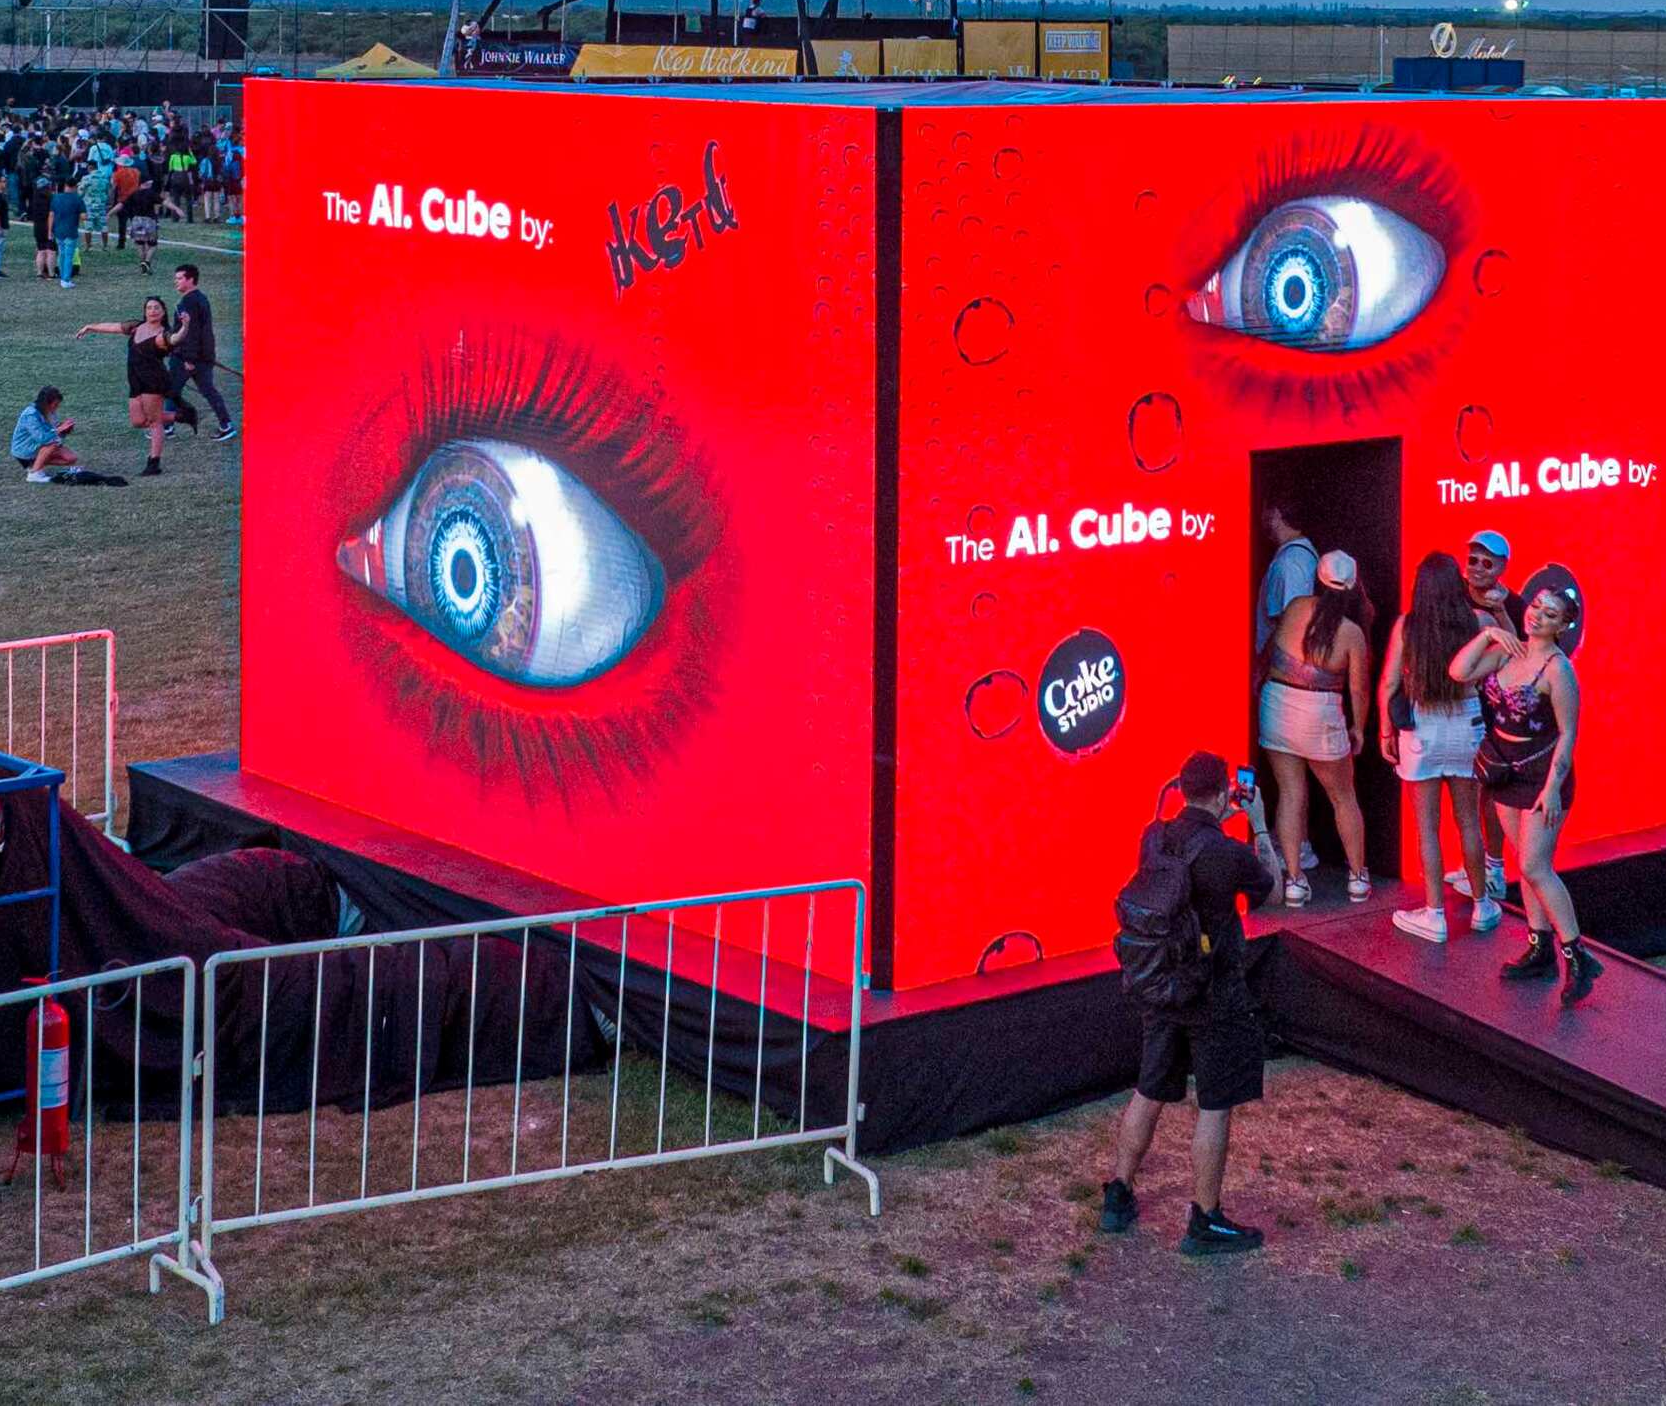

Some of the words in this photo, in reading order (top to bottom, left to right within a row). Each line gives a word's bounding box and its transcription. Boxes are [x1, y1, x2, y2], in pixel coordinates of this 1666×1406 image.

[524, 50, 566, 65] WALKER
[323, 192, 361, 224] The
[368, 183, 412, 229] AI.
[421, 188, 512, 239] Cube
[520, 210, 554, 250] by:
[1437, 478, 1477, 504] The
[1485, 461, 1530, 500] AI.
[1537, 453, 1621, 493] Cube
[1628, 459, 1657, 488] by:
[945, 535, 995, 564] The
[1005, 513, 1060, 557] AI.
[1070, 503, 1172, 549] Cube
[1181, 509, 1215, 541] by:
[1044, 656, 1116, 717] Coke
[1058, 684, 1114, 733] STUDIO
